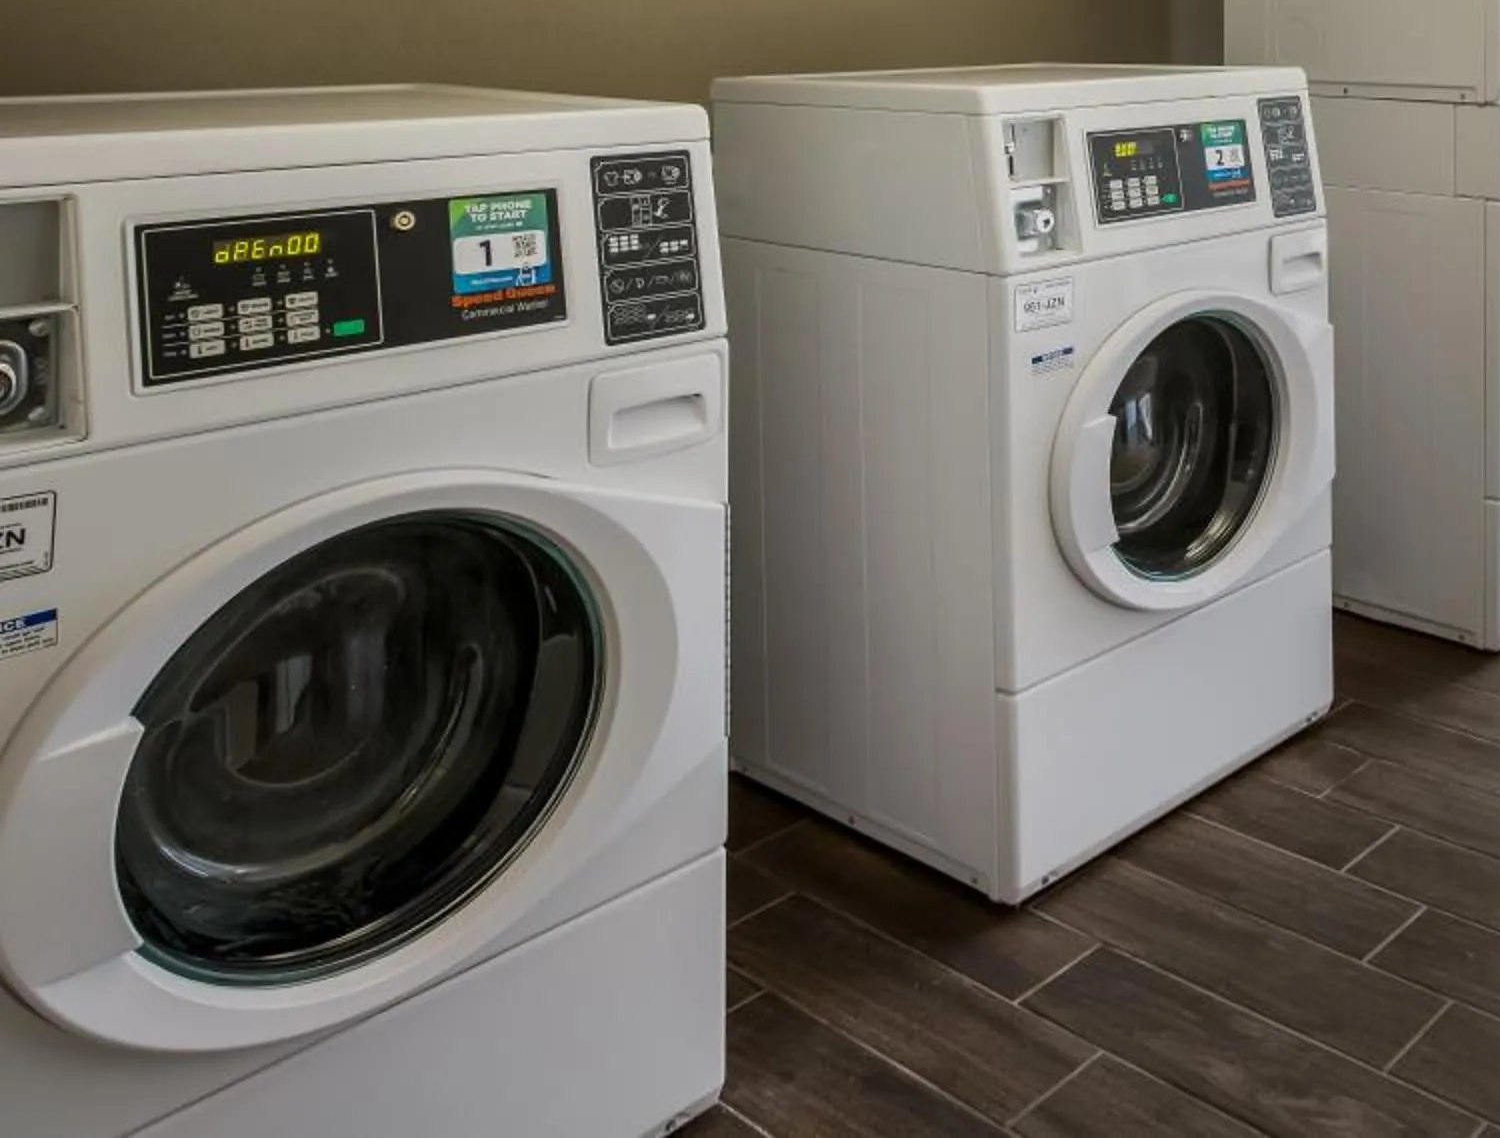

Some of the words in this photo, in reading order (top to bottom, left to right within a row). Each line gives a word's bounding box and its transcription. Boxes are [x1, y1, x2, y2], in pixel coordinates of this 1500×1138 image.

[1215, 149, 1225, 166] 2
[464, 203, 489, 214] TAP
[470, 213, 488, 223] TO
[489, 209, 527, 221] START
[479, 239, 493, 267] 1
[451, 290, 503, 309] Speed
[504, 284, 556, 300] Queen
[460, 305, 515, 321] Commercial
